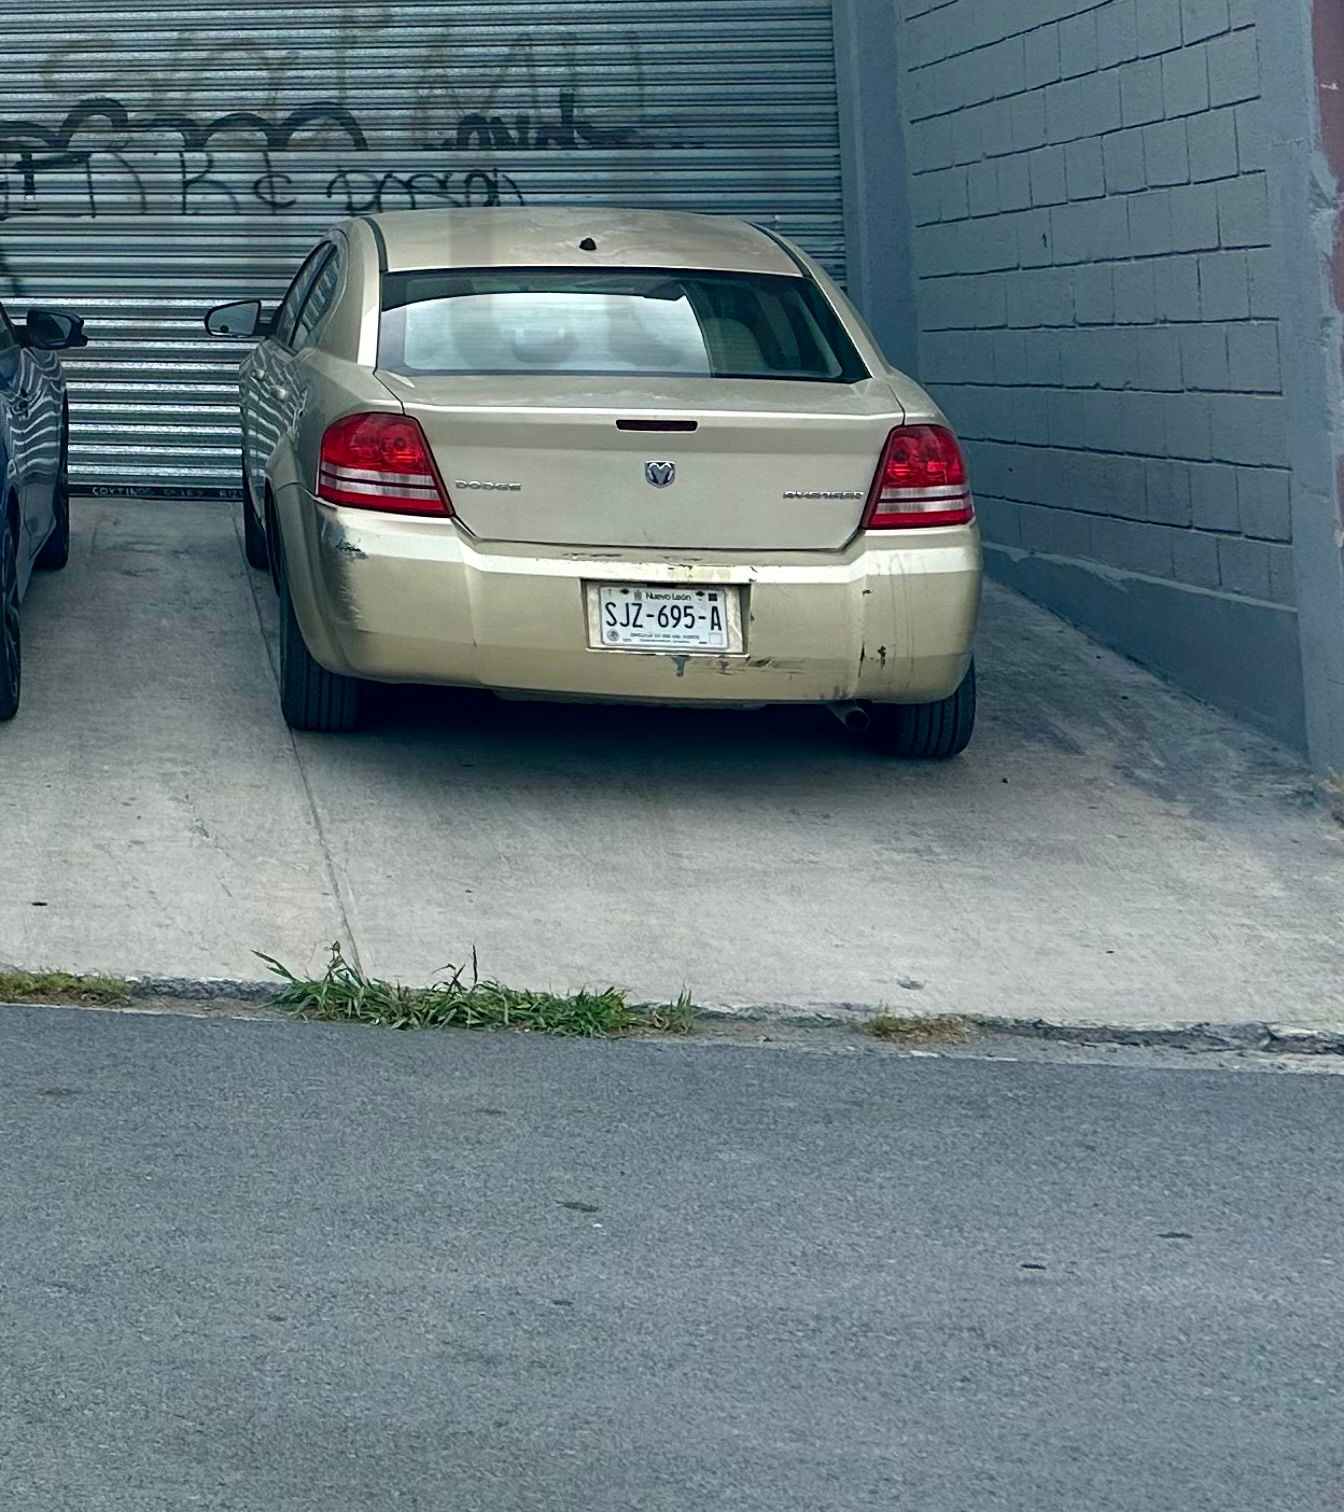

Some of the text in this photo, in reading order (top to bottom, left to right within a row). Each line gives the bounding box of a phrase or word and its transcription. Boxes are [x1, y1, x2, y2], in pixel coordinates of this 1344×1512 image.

[454, 479, 521, 491] DODGE
[646, 591, 671, 601] Nuevo
[604, 601, 722, 631] SJZ-695-A
